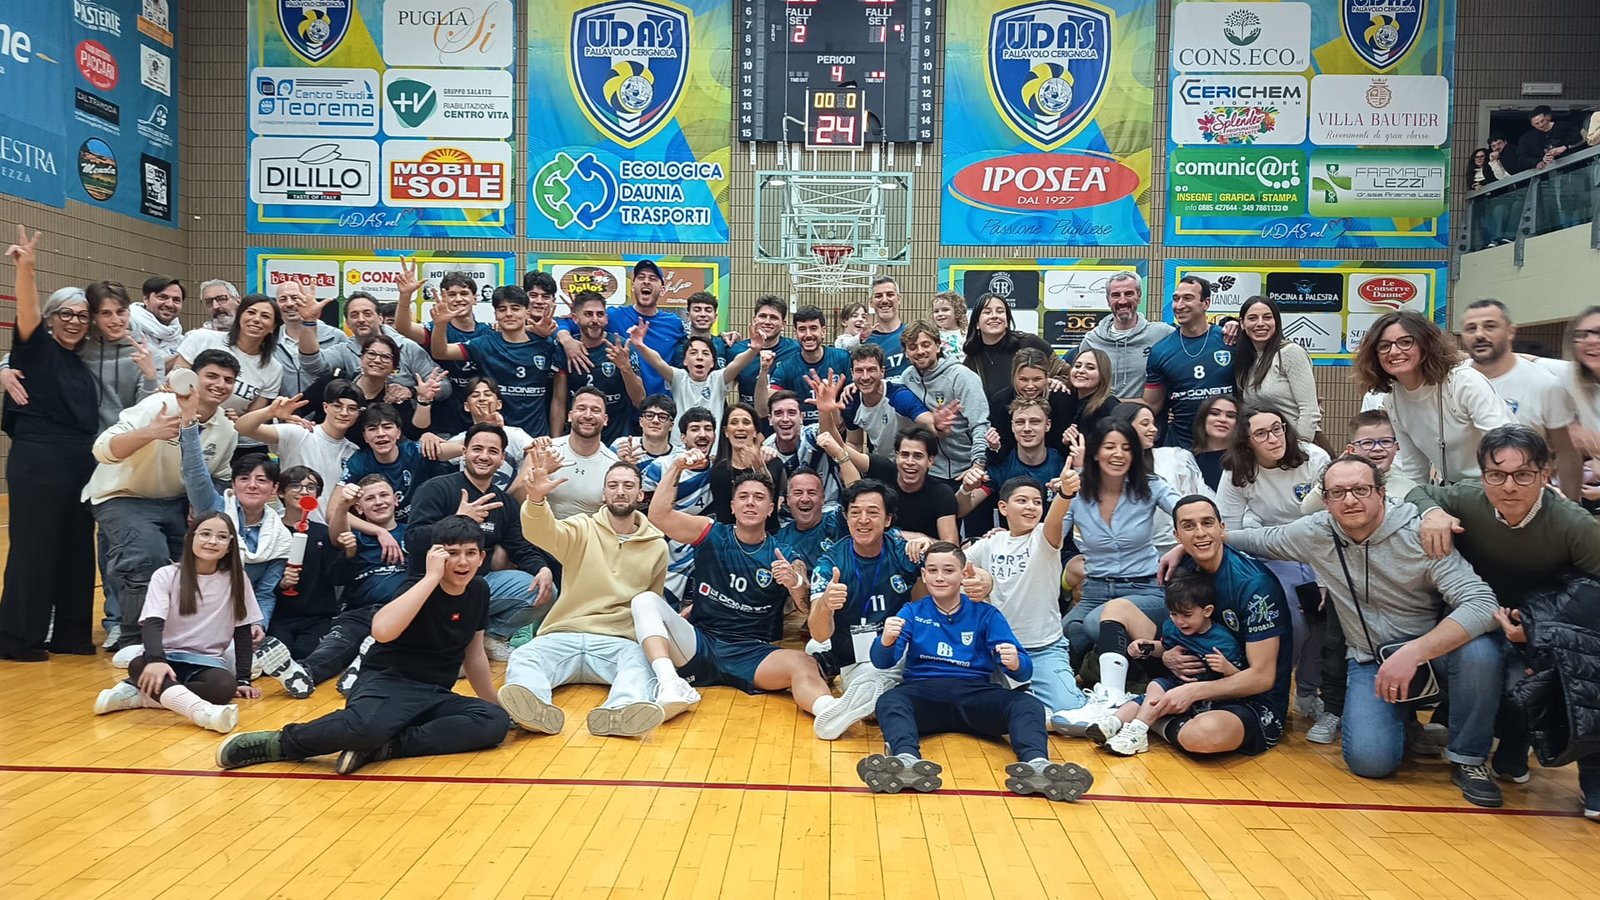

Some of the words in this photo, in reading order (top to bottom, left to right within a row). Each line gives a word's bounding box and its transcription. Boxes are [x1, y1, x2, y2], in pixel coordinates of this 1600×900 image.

[746, 7, 752, 15] 6
[786, 8, 812, 16] FALLI
[866, 8, 892, 16] FALLI
[925, 8, 931, 16] 6
[74, 0, 121, 33] PASTERIE
[398, 11, 468, 25] PUGLIA
[789, 17, 809, 25] SET
[868, 17, 888, 25] SET
[745, 21, 752, 29] 7
[924, 22, 931, 30] 7
[587, 19, 674, 48] UDAS
[794, 26, 806, 43] 2
[1005, 20, 1095, 50] UDAS
[745, 35, 752, 43] 8
[924, 35, 931, 43] 8
[585, 48, 630, 57] PALLAVOLO
[631, 48, 677, 57] CERIGNOLA
[745, 48, 752, 56] 9
[924, 49, 930, 57] 9
[1003, 50, 1049, 58] PALLAVOLO
[1051, 50, 1098, 58] CERIGNOLA
[1179, 48, 1295, 66] CONS.ECO
[817, 56, 856, 64] PERIODI
[742, 62, 752, 70] 10
[922, 63, 932, 71] 10
[742, 75, 752, 83] 11
[831, 66, 843, 82] 4
[922, 76, 931, 84] 11
[295, 90, 333, 99] Centro
[336, 90, 365, 99] Studi
[742, 89, 752, 97] 12
[1187, 86, 1301, 98] CERICHEM
[276, 97, 374, 116] Teorema
[922, 103, 931, 111] 13
[487, 111, 509, 119] VITA
[1318, 112, 1364, 126] VILLA
[1371, 112, 1439, 126] BAUTIER
[921, 117, 931, 125] 14
[741, 129, 752, 137] 15
[815, 116, 855, 144] 24
[921, 130, 931, 138] 15
[1373, 130, 1380, 139] di
[1385, 133, 1402, 141] gran
[394, 163, 501, 176] MOBILI
[621, 162, 723, 179] ECOLOGICA
[1175, 156, 1300, 188] comunic@rt
[1355, 167, 1442, 178] FARMACIA
[266, 166, 362, 188] DILILLO
[982, 166, 1108, 192] IPOSEA
[394, 177, 408, 187] IL
[408, 177, 501, 198] SOLE
[1373, 178, 1424, 188] LEZZI
[621, 185, 683, 201] DAUNIA
[1176, 193, 1213, 201] INSEGNE
[1219, 193, 1256, 202] GRAFICA
[1262, 194, 1298, 202] STAMPA
[1017, 196, 1040, 205] DAL
[1045, 196, 1075, 205] 1927
[339, 212, 386, 228] UDAS
[621, 208, 711, 225] TRASPORTI
[979, 218, 1041, 235] Passione
[1050, 218, 1112, 239] Pugliese
[1261, 223, 1312, 239] UDAS
[573, 274, 591, 283] Los
[1382, 279, 1395, 287] Le
[568, 283, 604, 293] Pollos
[1269, 292, 1297, 301] PISCINA
[1305, 292, 1339, 301] PALESTRA
[887, 353, 904, 367] 17
[515, 366, 526, 378] 3
[1193, 365, 1206, 379] 8
[586, 374, 594, 387] 2
[695, 496, 705, 508] 4
[729, 573, 748, 593] 10
[869, 594, 886, 612] 11
